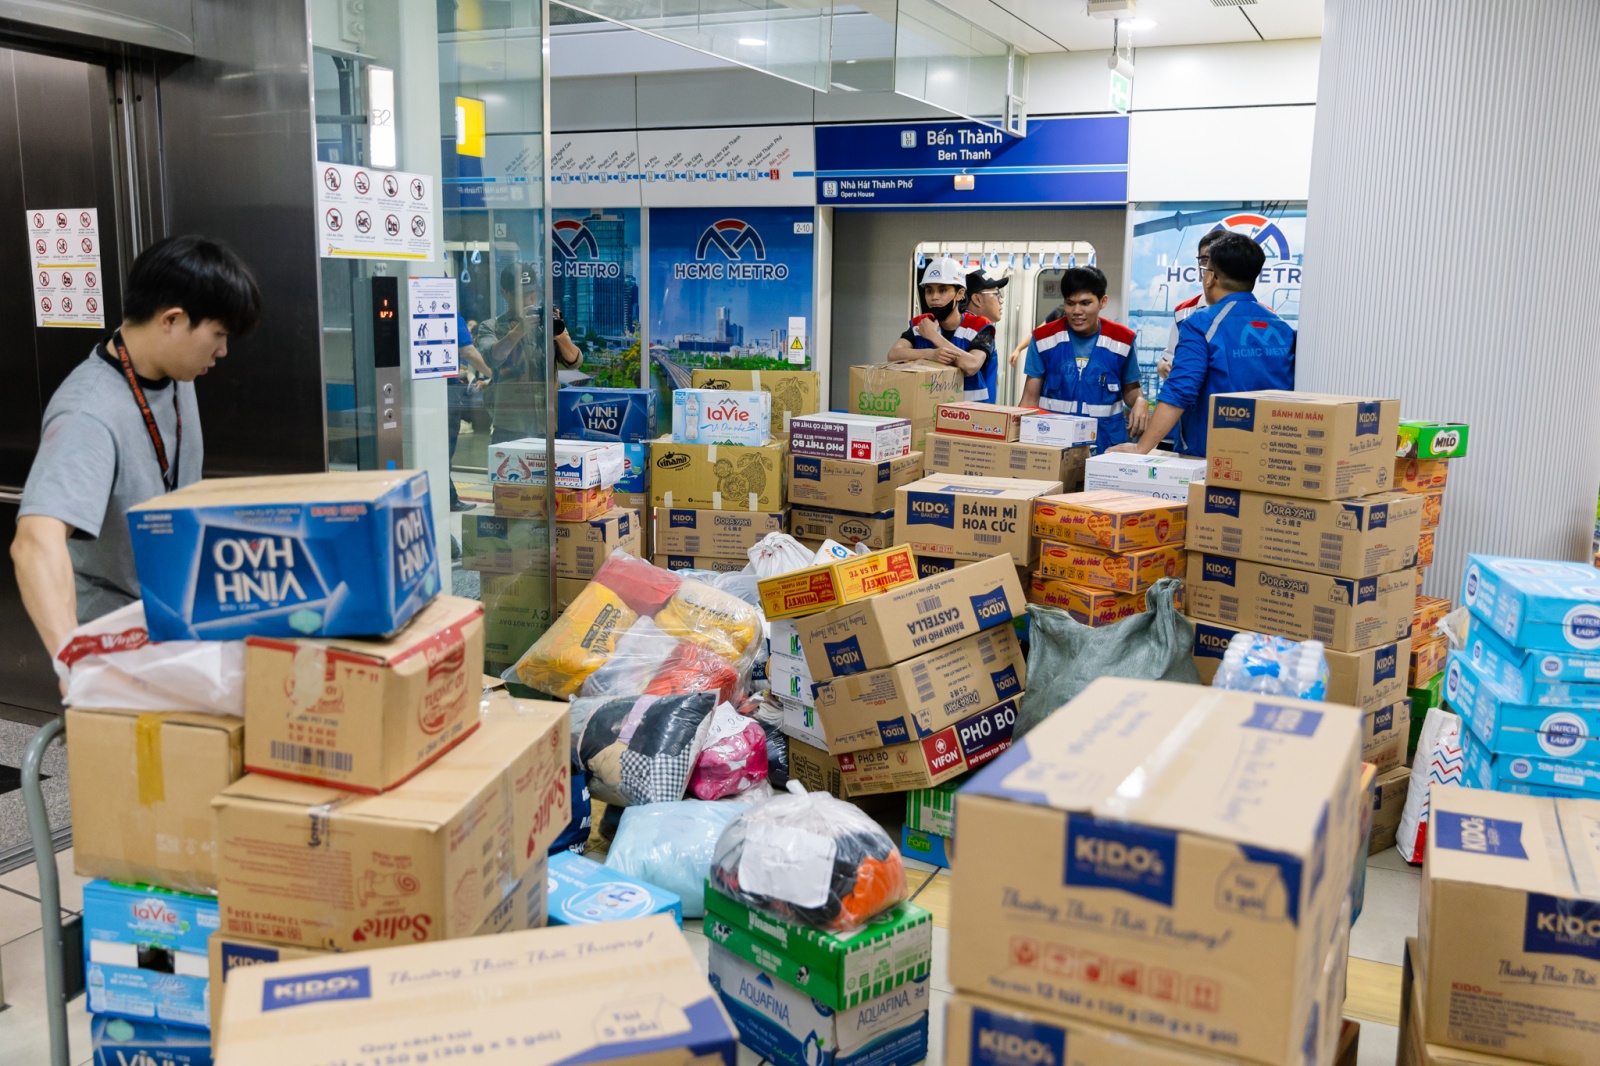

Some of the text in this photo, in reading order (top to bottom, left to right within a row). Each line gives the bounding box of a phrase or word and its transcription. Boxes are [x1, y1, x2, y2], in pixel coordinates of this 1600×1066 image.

[926, 128, 1003, 146] Bến Thành
[938, 149, 992, 161] Ben Thanh
[840, 179, 914, 190] Nhà Hát Thành Phố
[796, 223, 811, 234] 2-10
[565, 262, 620, 279] METRO
[674, 263, 789, 280] HCMC METRO
[859, 388, 900, 411] Staff
[707, 405, 750, 421] laVie
[941, 409, 971, 422] Gấu Đỏ
[1218, 407, 1250, 418] KIDO's
[1271, 409, 1324, 422] BÁNH MÌ MẶN
[1359, 412, 1377, 423] KIDO's
[801, 420, 812, 429] THỊT
[813, 422, 821, 430] CÓ
[792, 439, 844, 452] PHỞ THỊT BÒ
[1435, 437, 1456, 448] MILO
[660, 456, 688, 467] vinamit
[796, 464, 818, 473] KIDO's
[912, 501, 949, 514] KIDO's
[1208, 494, 1236, 506] KIDO's
[672, 514, 694, 522] KIDO's
[963, 502, 1017, 519] BÁNH MÌ
[1264, 501, 1316, 521] DORA-YAKI
[963, 518, 1015, 533] HOA CÚC
[670, 560, 692, 568] KIDO's
[1206, 563, 1232, 575] KIDO's
[214, 570, 307, 606] VĨNH
[866, 572, 900, 590] MILIKET
[1258, 571, 1309, 594] DORA-YAKI
[785, 593, 818, 608] MILIKET
[978, 600, 1007, 619] KIDO's
[907, 606, 960, 635] CASTELLA
[912, 621, 966, 648] BÁNH PHÔ MAI
[832, 650, 860, 666] KIDO's
[997, 677, 1017, 692] KIDO's
[883, 726, 906, 738] KIDO's
[960, 706, 1016, 745] PHỞ BÒ
[1550, 724, 1578, 734] DUTCH
[858, 752, 889, 764] PHỞ BÒ
[931, 751, 959, 770] VIFON
[1074, 836, 1166, 875] KIDO's
[132, 905, 177, 924] laVie
[366, 913, 432, 942] Solite
[274, 975, 360, 999] KIDO's
[914, 986, 924, 996] 24
[739, 977, 792, 1027] AQUAFINA
[857, 990, 911, 1030] AQUAFINA
[979, 1027, 1056, 1065] KIDO's
